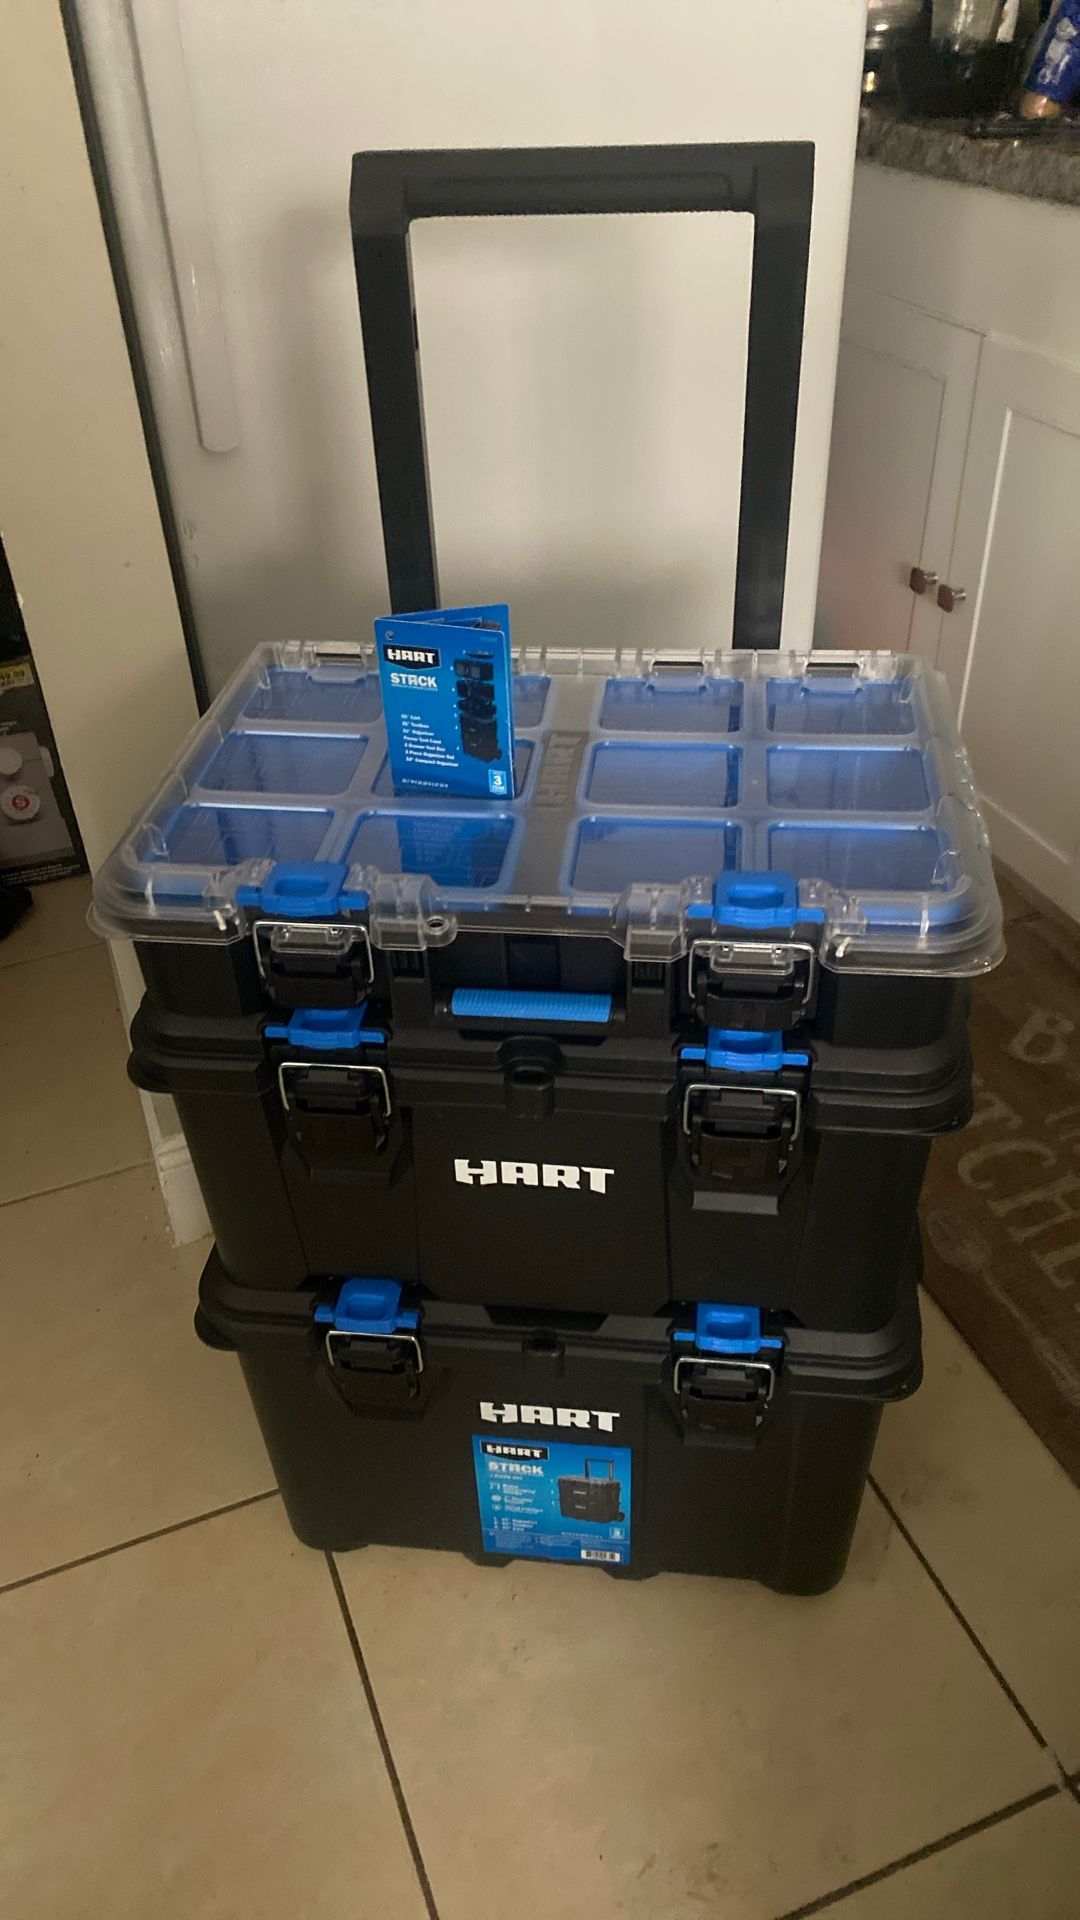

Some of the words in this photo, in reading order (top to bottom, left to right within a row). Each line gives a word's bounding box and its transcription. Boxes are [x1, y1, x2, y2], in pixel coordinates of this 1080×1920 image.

[387, 648, 435, 664] HART
[390, 672, 438, 688] STACK
[493, 775, 502, 786] 3
[454, 1158, 615, 1194] HART
[480, 1401, 620, 1432] HART
[486, 1444, 542, 1458] HART
[488, 1461, 543, 1474] STACK
